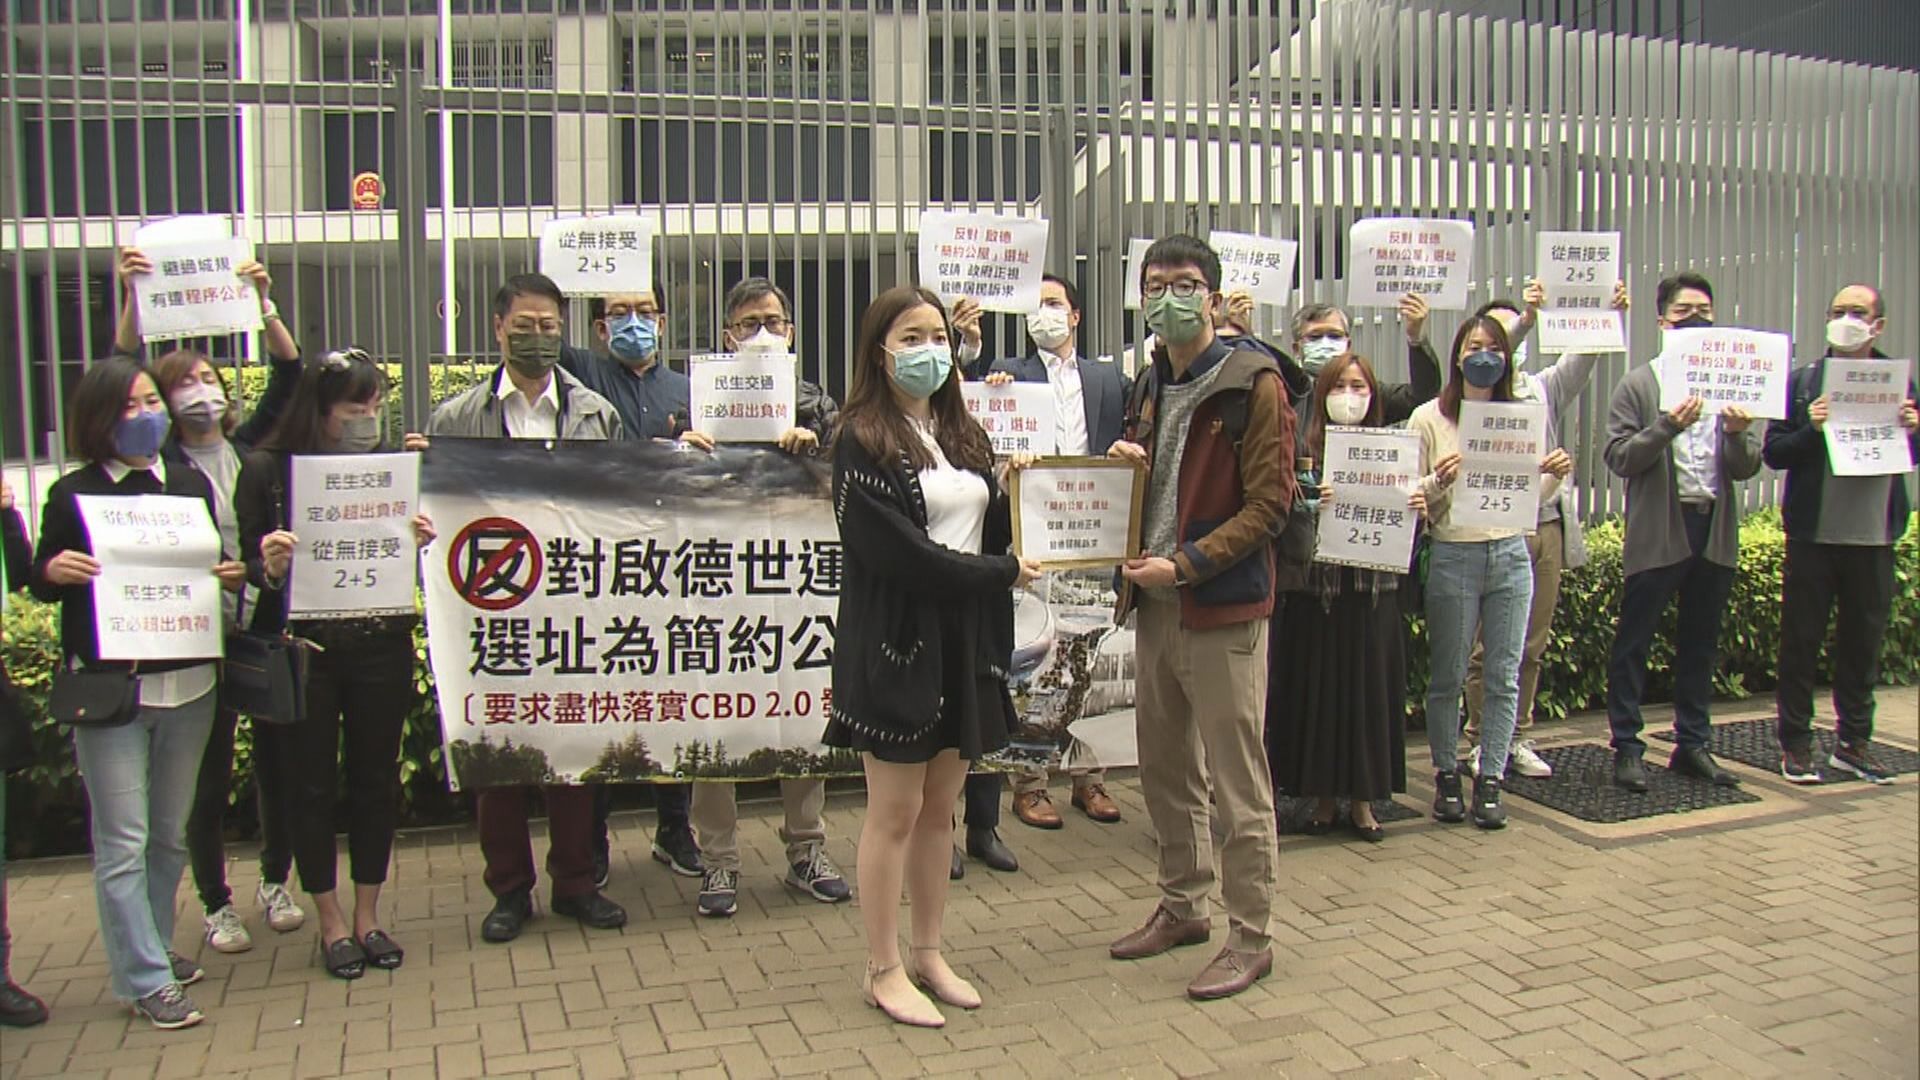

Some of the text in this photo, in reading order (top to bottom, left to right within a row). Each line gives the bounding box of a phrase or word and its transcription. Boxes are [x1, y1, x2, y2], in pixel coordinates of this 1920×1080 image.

[559, 231, 637, 250] 從無接受
[955, 227, 978, 241] 反對
[1389, 231, 1412, 244] 反對
[1220, 247, 1280, 270] 從無接受
[1552, 245, 1610, 262] 從無接受
[577, 257, 616, 273] 2+5
[968, 264, 1019, 280] 政府正視
[1404, 265, 1448, 278] 政府正視
[1230, 269, 1260, 286] 2+5
[1566, 267, 1595, 282] 2+5
[1702, 341, 1725, 352] 反對
[715, 375, 774, 390] 民生交通
[701, 403, 787, 418] 定必超出負荷
[983, 417, 1038, 432] 屋」選址
[1834, 425, 1894, 443] 從無接受
[1348, 447, 1398, 462] 民生交通
[1854, 447, 1880, 460] 2+5
[326, 471, 392, 490] 民生交通
[1333, 471, 1409, 486] 定必超出負荷
[1467, 471, 1529, 492] 從無接受
[307, 501, 407, 522] 定必超出負荷
[1480, 495, 1511, 512] 2+5
[103, 509, 196, 527] 從無接受
[1335, 503, 1403, 528] 從無接受
[136, 530, 180, 546] 2+5
[1348, 528, 1382, 546] 2+5
[312, 537, 401, 561] 從無接受
[334, 569, 377, 588] 2+5
[124, 584, 191, 600] 民生交通
[109, 616, 210, 632] 定必超出負荷
[469, 614, 838, 676] 選址為簡約公
[765, 690, 811, 718] 2.0
